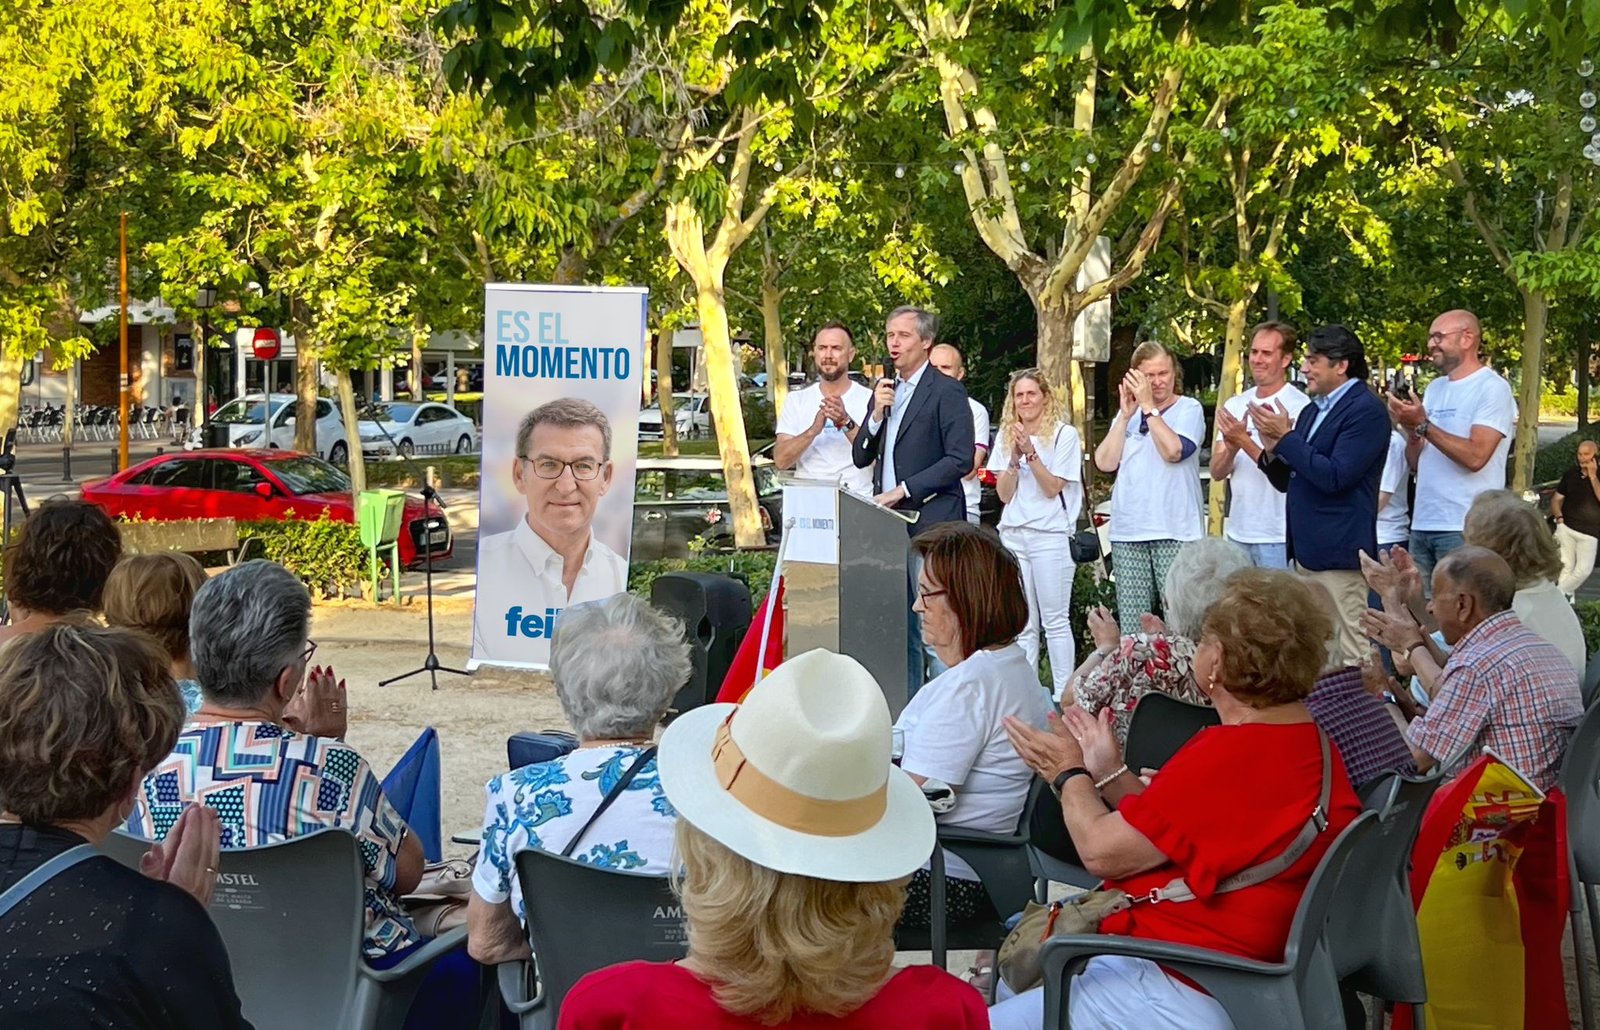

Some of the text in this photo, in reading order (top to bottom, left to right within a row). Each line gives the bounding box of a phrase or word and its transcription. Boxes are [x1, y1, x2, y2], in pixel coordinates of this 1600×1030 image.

[496, 309, 570, 345] ES EL
[496, 344, 630, 381] MOMENTO
[505, 605, 563, 639] fei
[653, 905, 688, 919] AM
